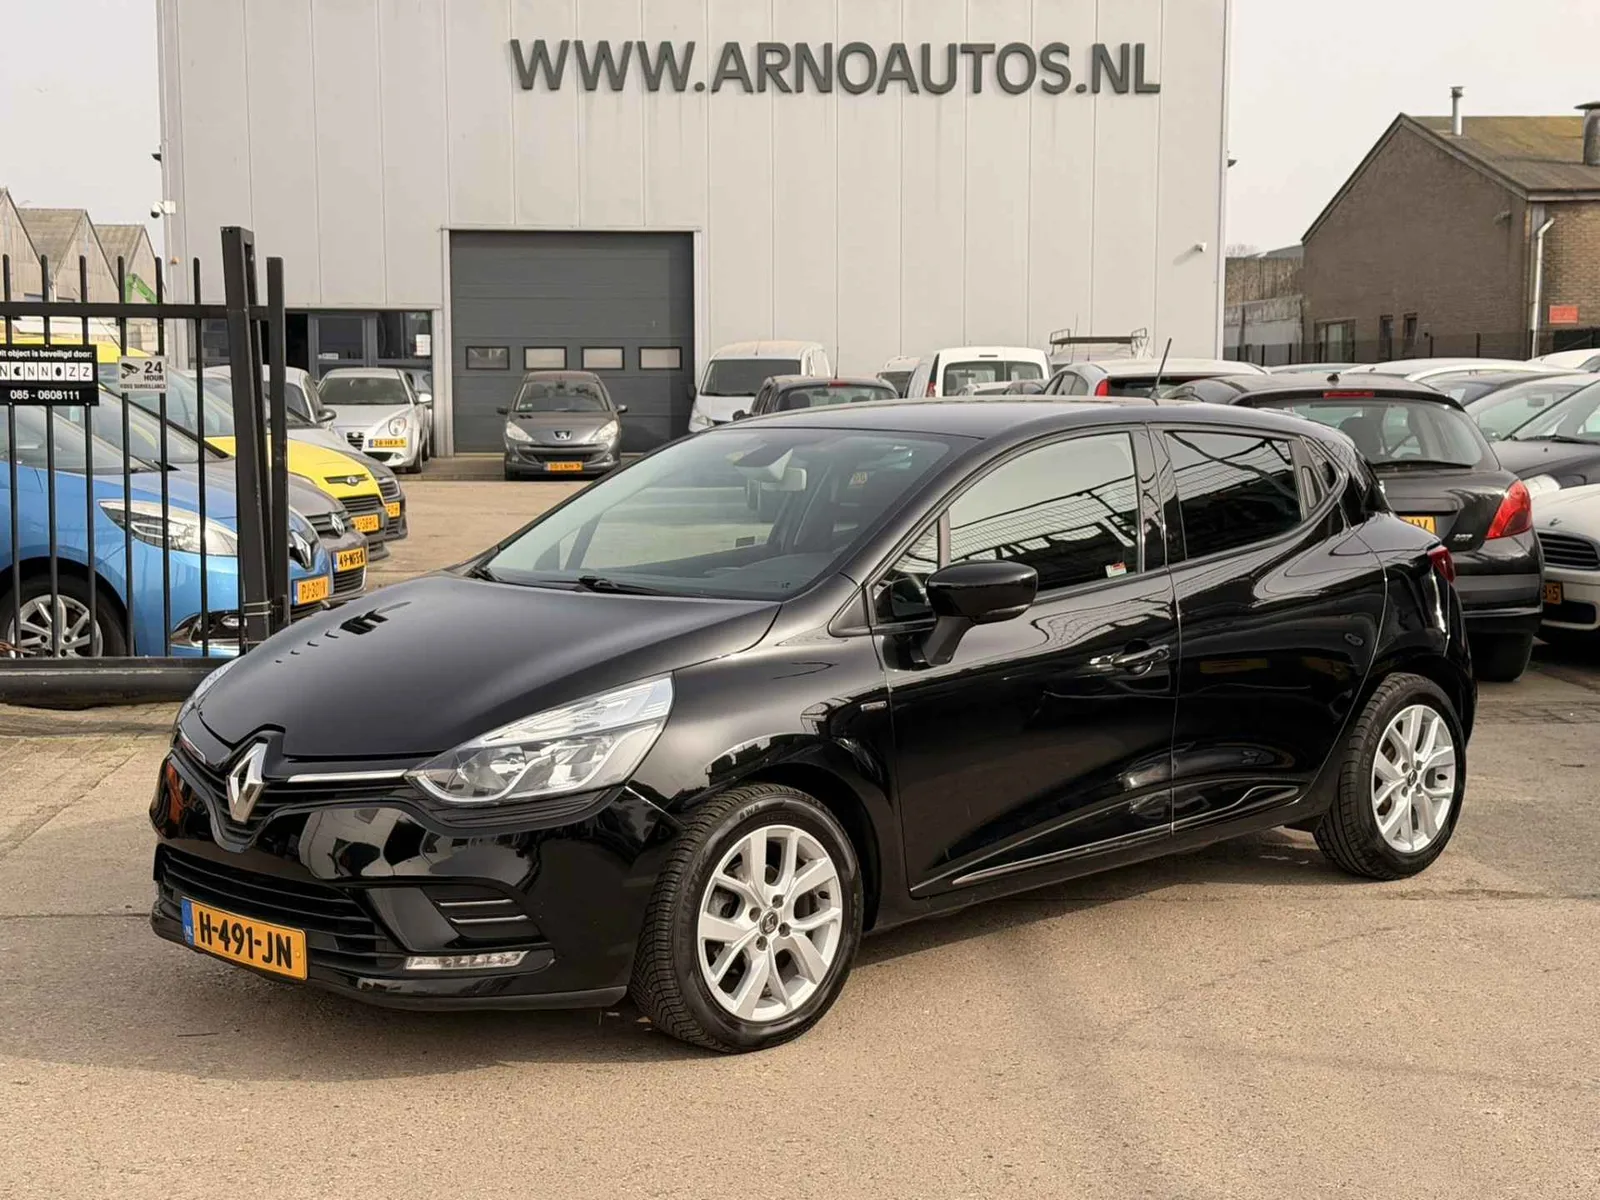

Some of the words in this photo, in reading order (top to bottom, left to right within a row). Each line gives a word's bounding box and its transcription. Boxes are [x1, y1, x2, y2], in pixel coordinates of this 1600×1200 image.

[510, 39, 1161, 95] WWW.ARNOAUTOS.NL
[8, 350, 31, 359] object
[40, 350, 72, 359] beveiligd
[144, 361, 163, 374] 24
[144, 374, 164, 382] HOUR
[10, 390, 30, 400] 085
[38, 390, 80, 400] 0608111
[199, 911, 292, 970] H-491-JN
